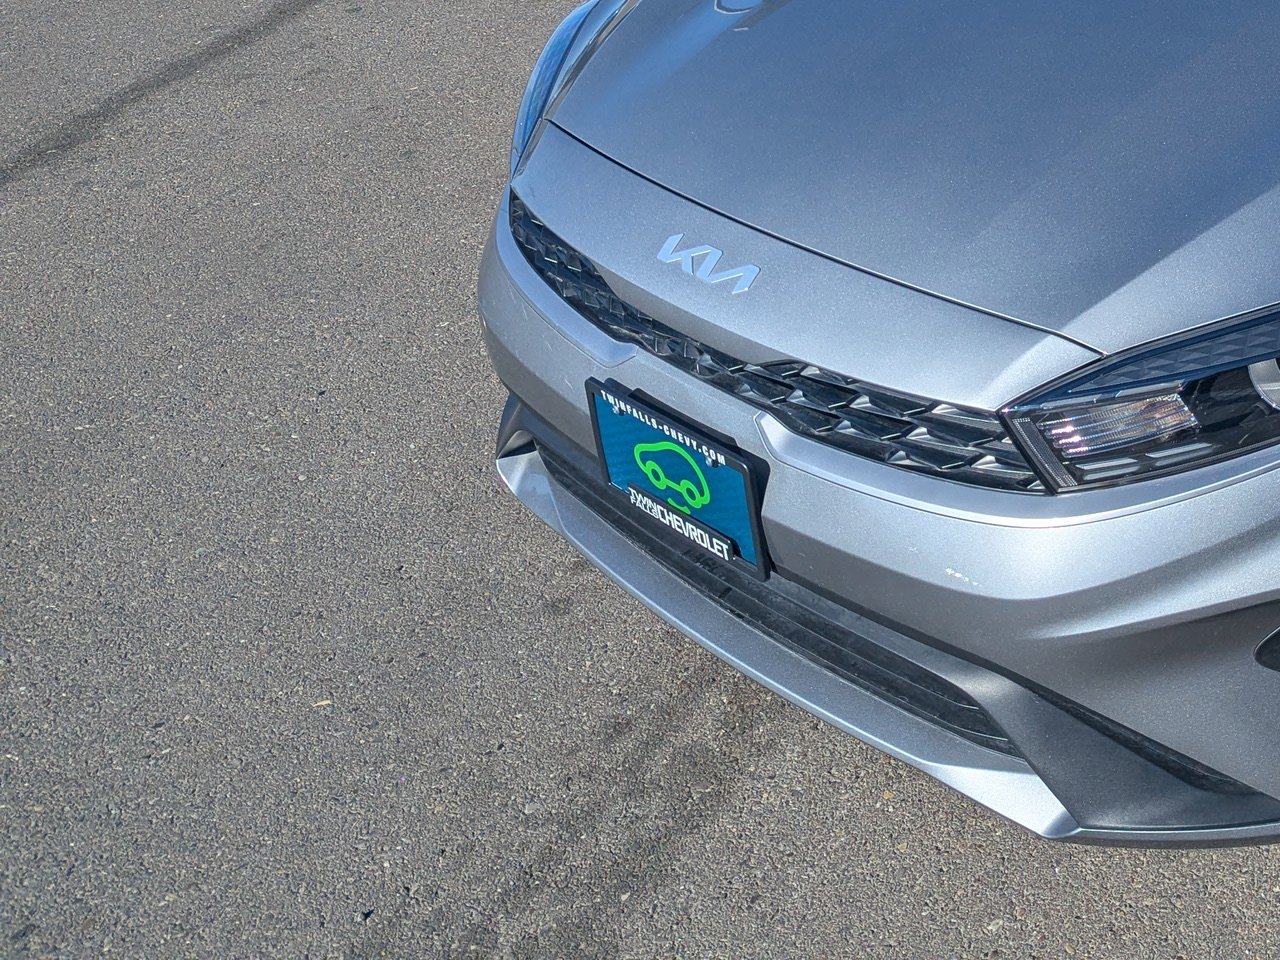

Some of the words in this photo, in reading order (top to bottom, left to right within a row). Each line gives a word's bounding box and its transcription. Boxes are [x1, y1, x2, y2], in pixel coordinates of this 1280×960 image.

[601, 390, 726, 466] TWINFALLS-CHEVY.COM
[628, 487, 658, 511] TWIN
[656, 504, 729, 560] CHEVROLET
